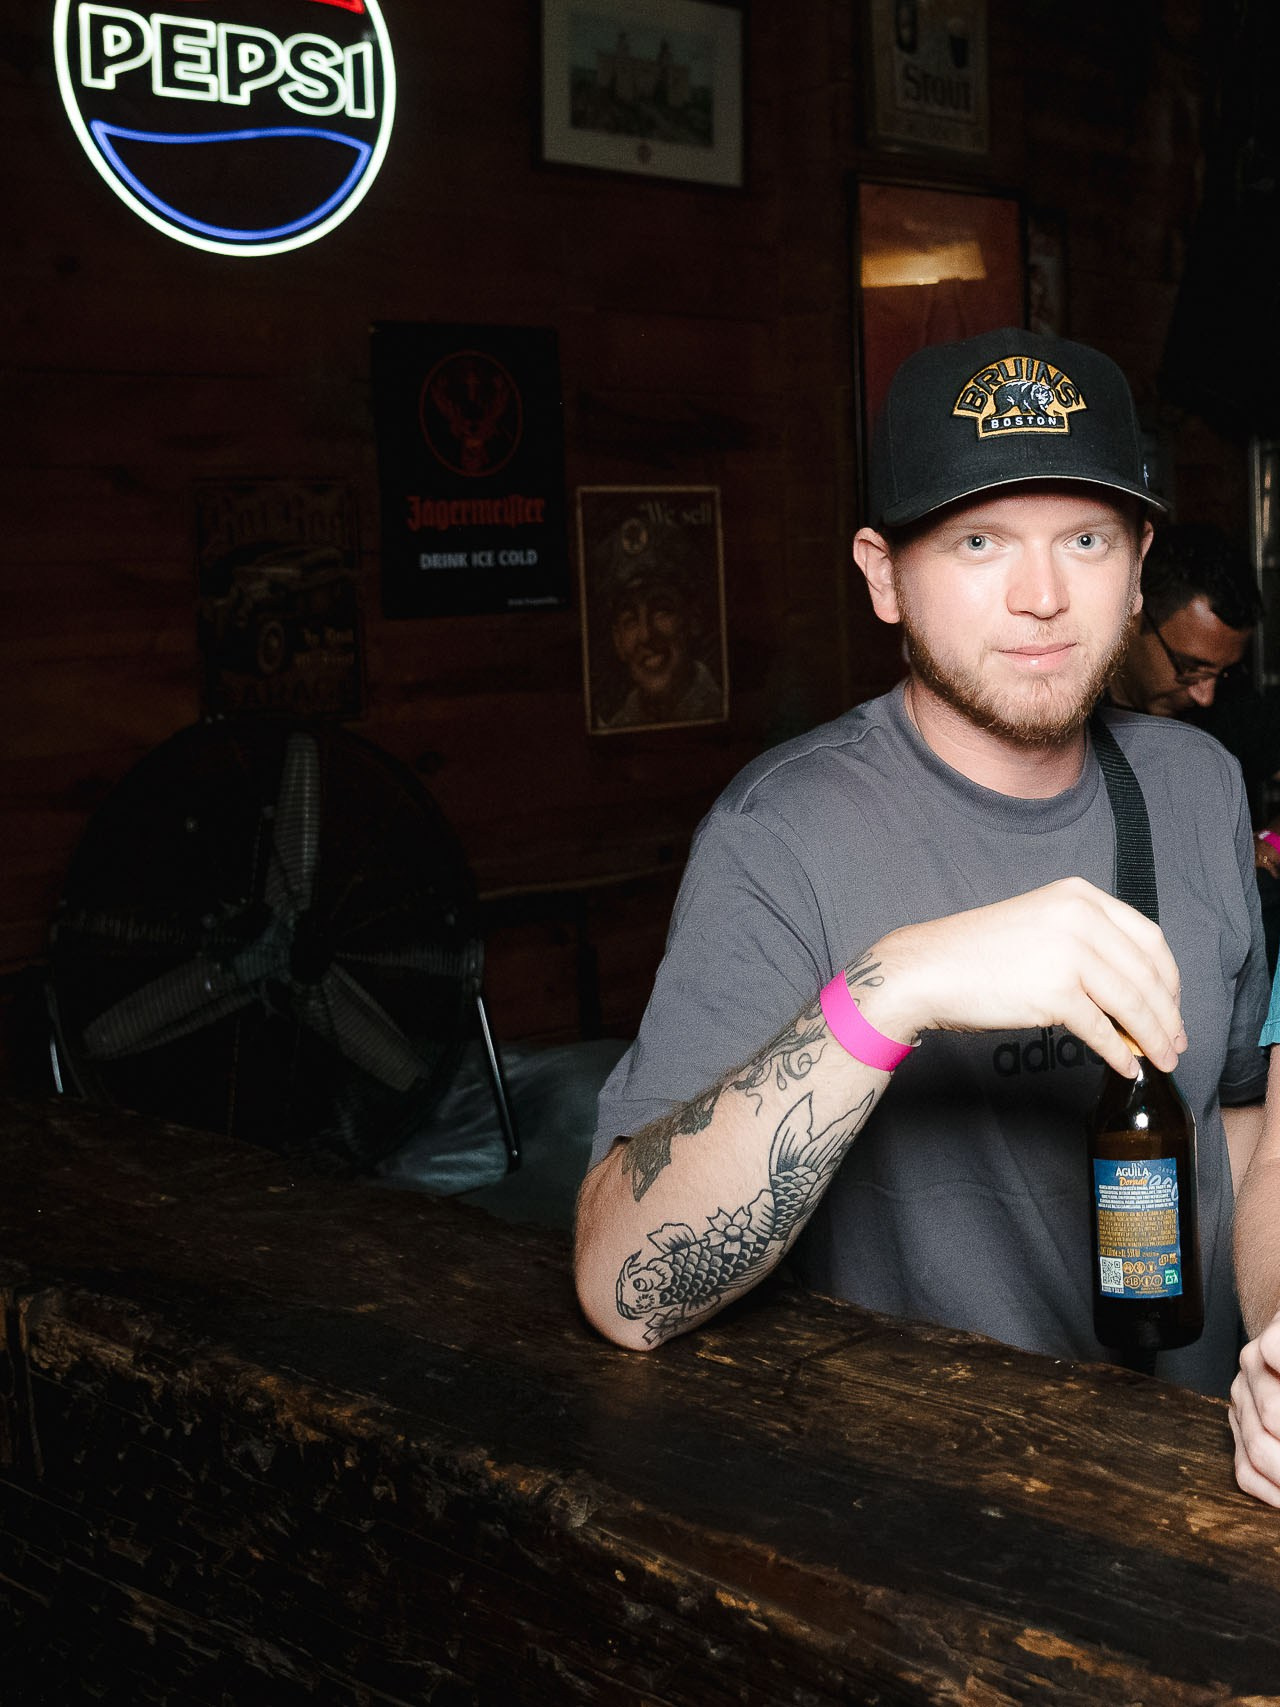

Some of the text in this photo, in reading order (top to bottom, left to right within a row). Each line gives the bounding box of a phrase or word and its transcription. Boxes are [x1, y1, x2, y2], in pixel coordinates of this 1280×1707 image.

[78, 2, 376, 120] PEPSI
[957, 358, 1081, 415] BRUINS
[991, 416, 1057, 429] BOSTON
[420, 549, 538, 570] DRINK ICE COLD
